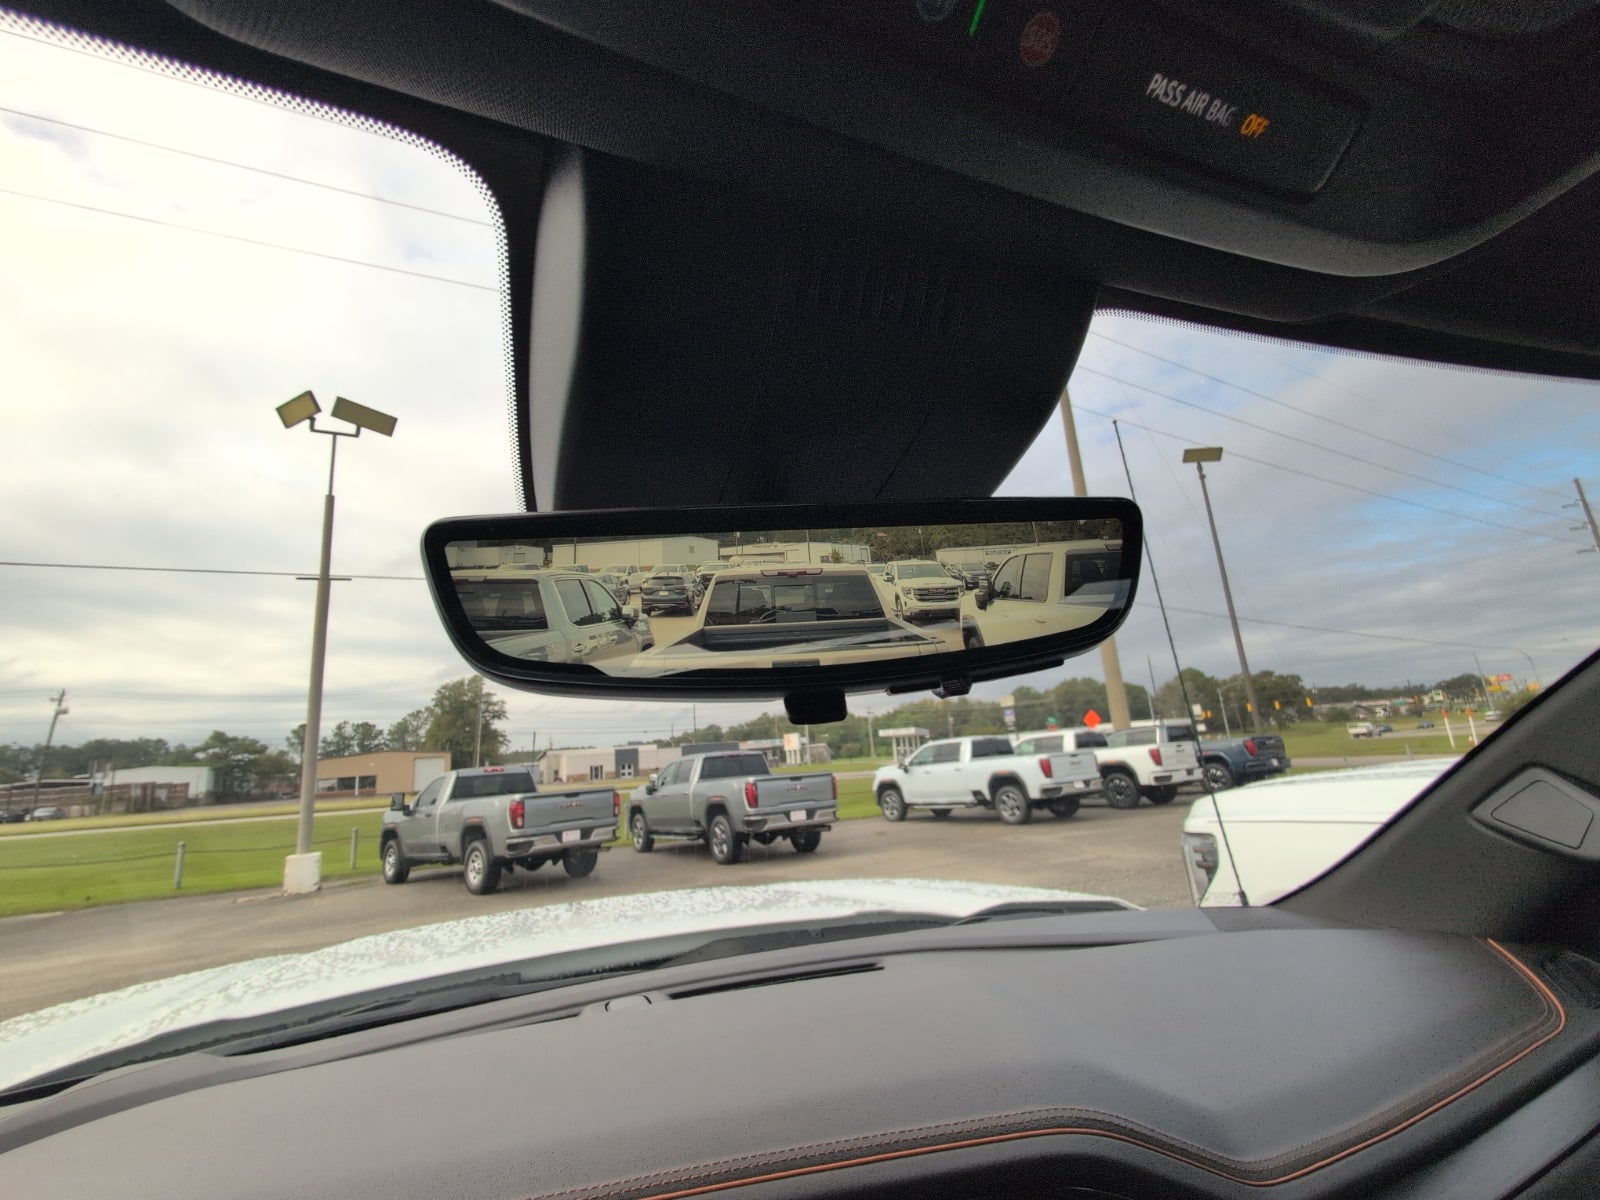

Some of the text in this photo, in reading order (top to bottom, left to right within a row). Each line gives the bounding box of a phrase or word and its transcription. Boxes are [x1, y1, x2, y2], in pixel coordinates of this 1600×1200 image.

[1145, 72, 1188, 107] PASS
[1180, 89, 1211, 117] AIR
[1241, 112, 1271, 138] OFF
